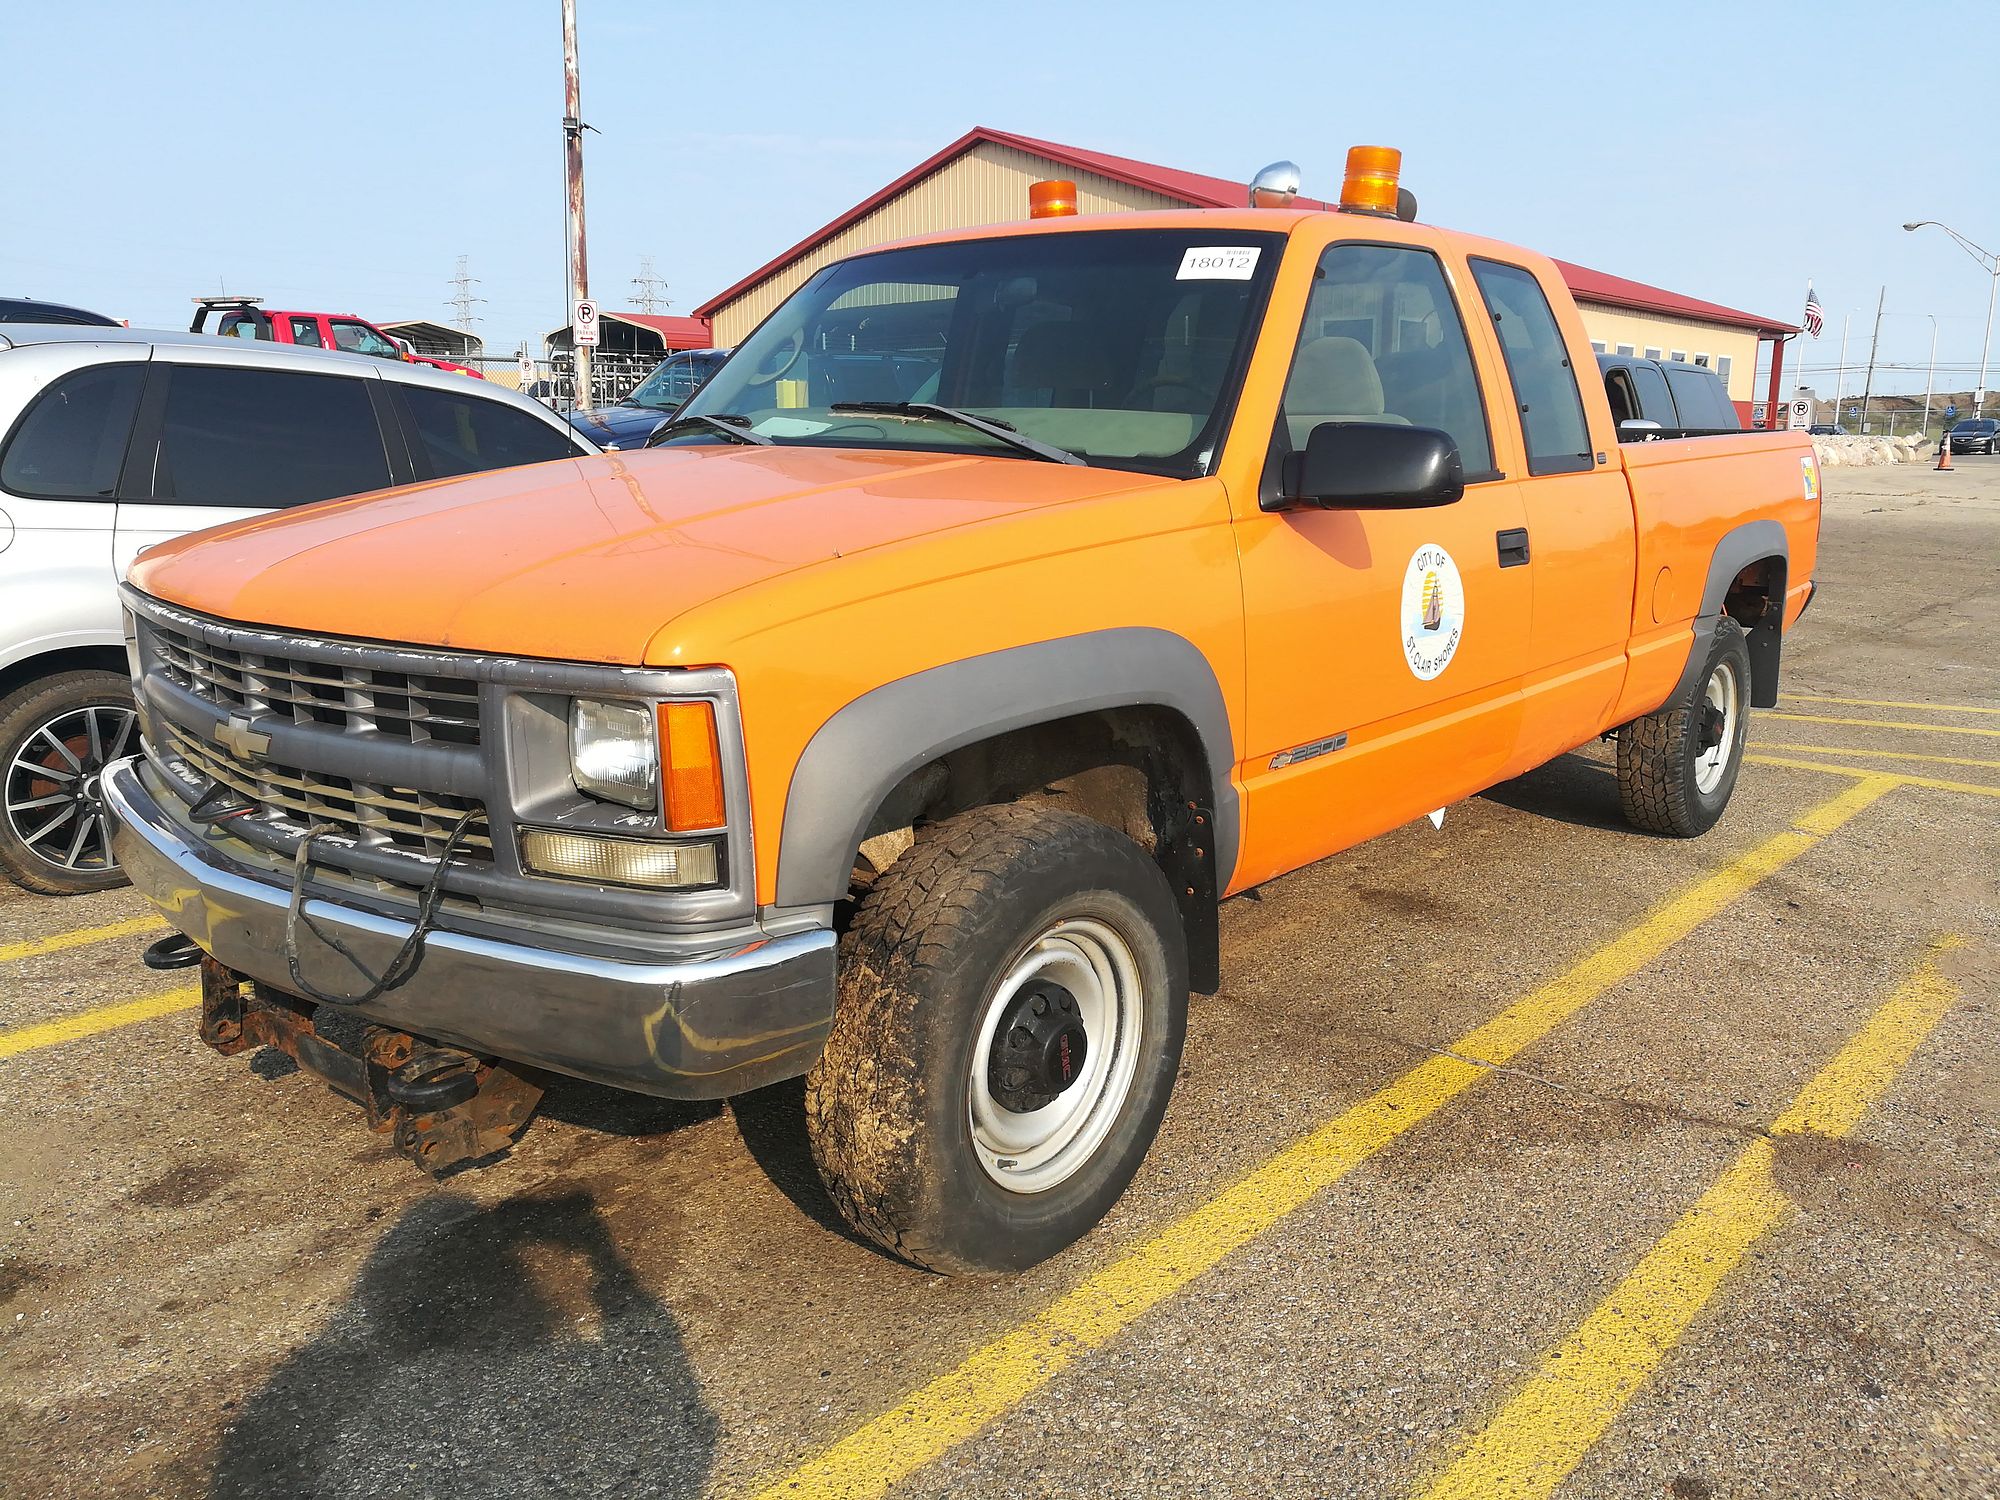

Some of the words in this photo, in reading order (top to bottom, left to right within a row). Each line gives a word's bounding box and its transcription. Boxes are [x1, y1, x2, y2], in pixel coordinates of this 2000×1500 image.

[1189, 257, 1250, 269] 18012
[1417, 551, 1432, 571] CITY
[1435, 552, 1446, 568] OF
[1413, 652, 1431, 674] CLAIR
[1433, 627, 1459, 671] SHORES
[1292, 732, 1348, 763] 2500
